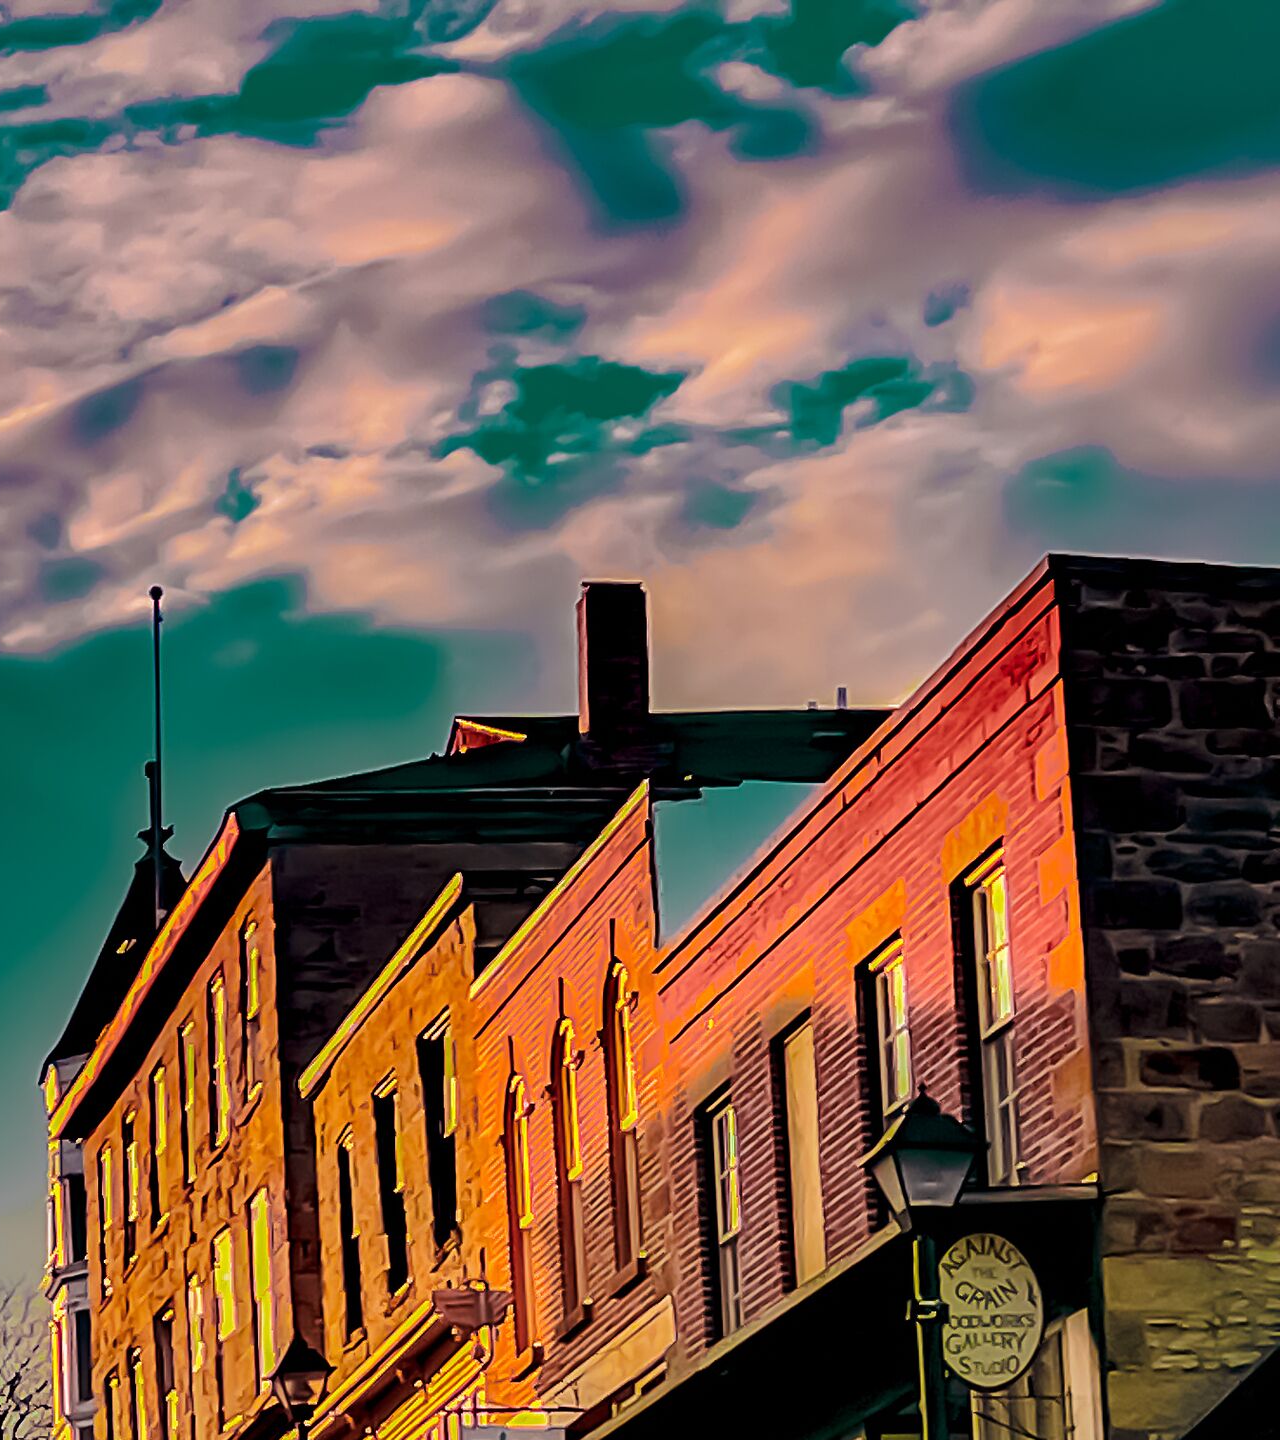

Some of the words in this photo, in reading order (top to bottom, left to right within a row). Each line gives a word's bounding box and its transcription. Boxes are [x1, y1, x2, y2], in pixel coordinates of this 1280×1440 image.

[941, 1234, 1027, 1279] AGAINST
[971, 1266, 998, 1280] THE
[955, 1279, 1018, 1310] GRAIN
[949, 1313, 1036, 1329] OODWORKS
[946, 1330, 1028, 1354] GALLERY
[958, 1355, 1020, 1376] STUDIO
